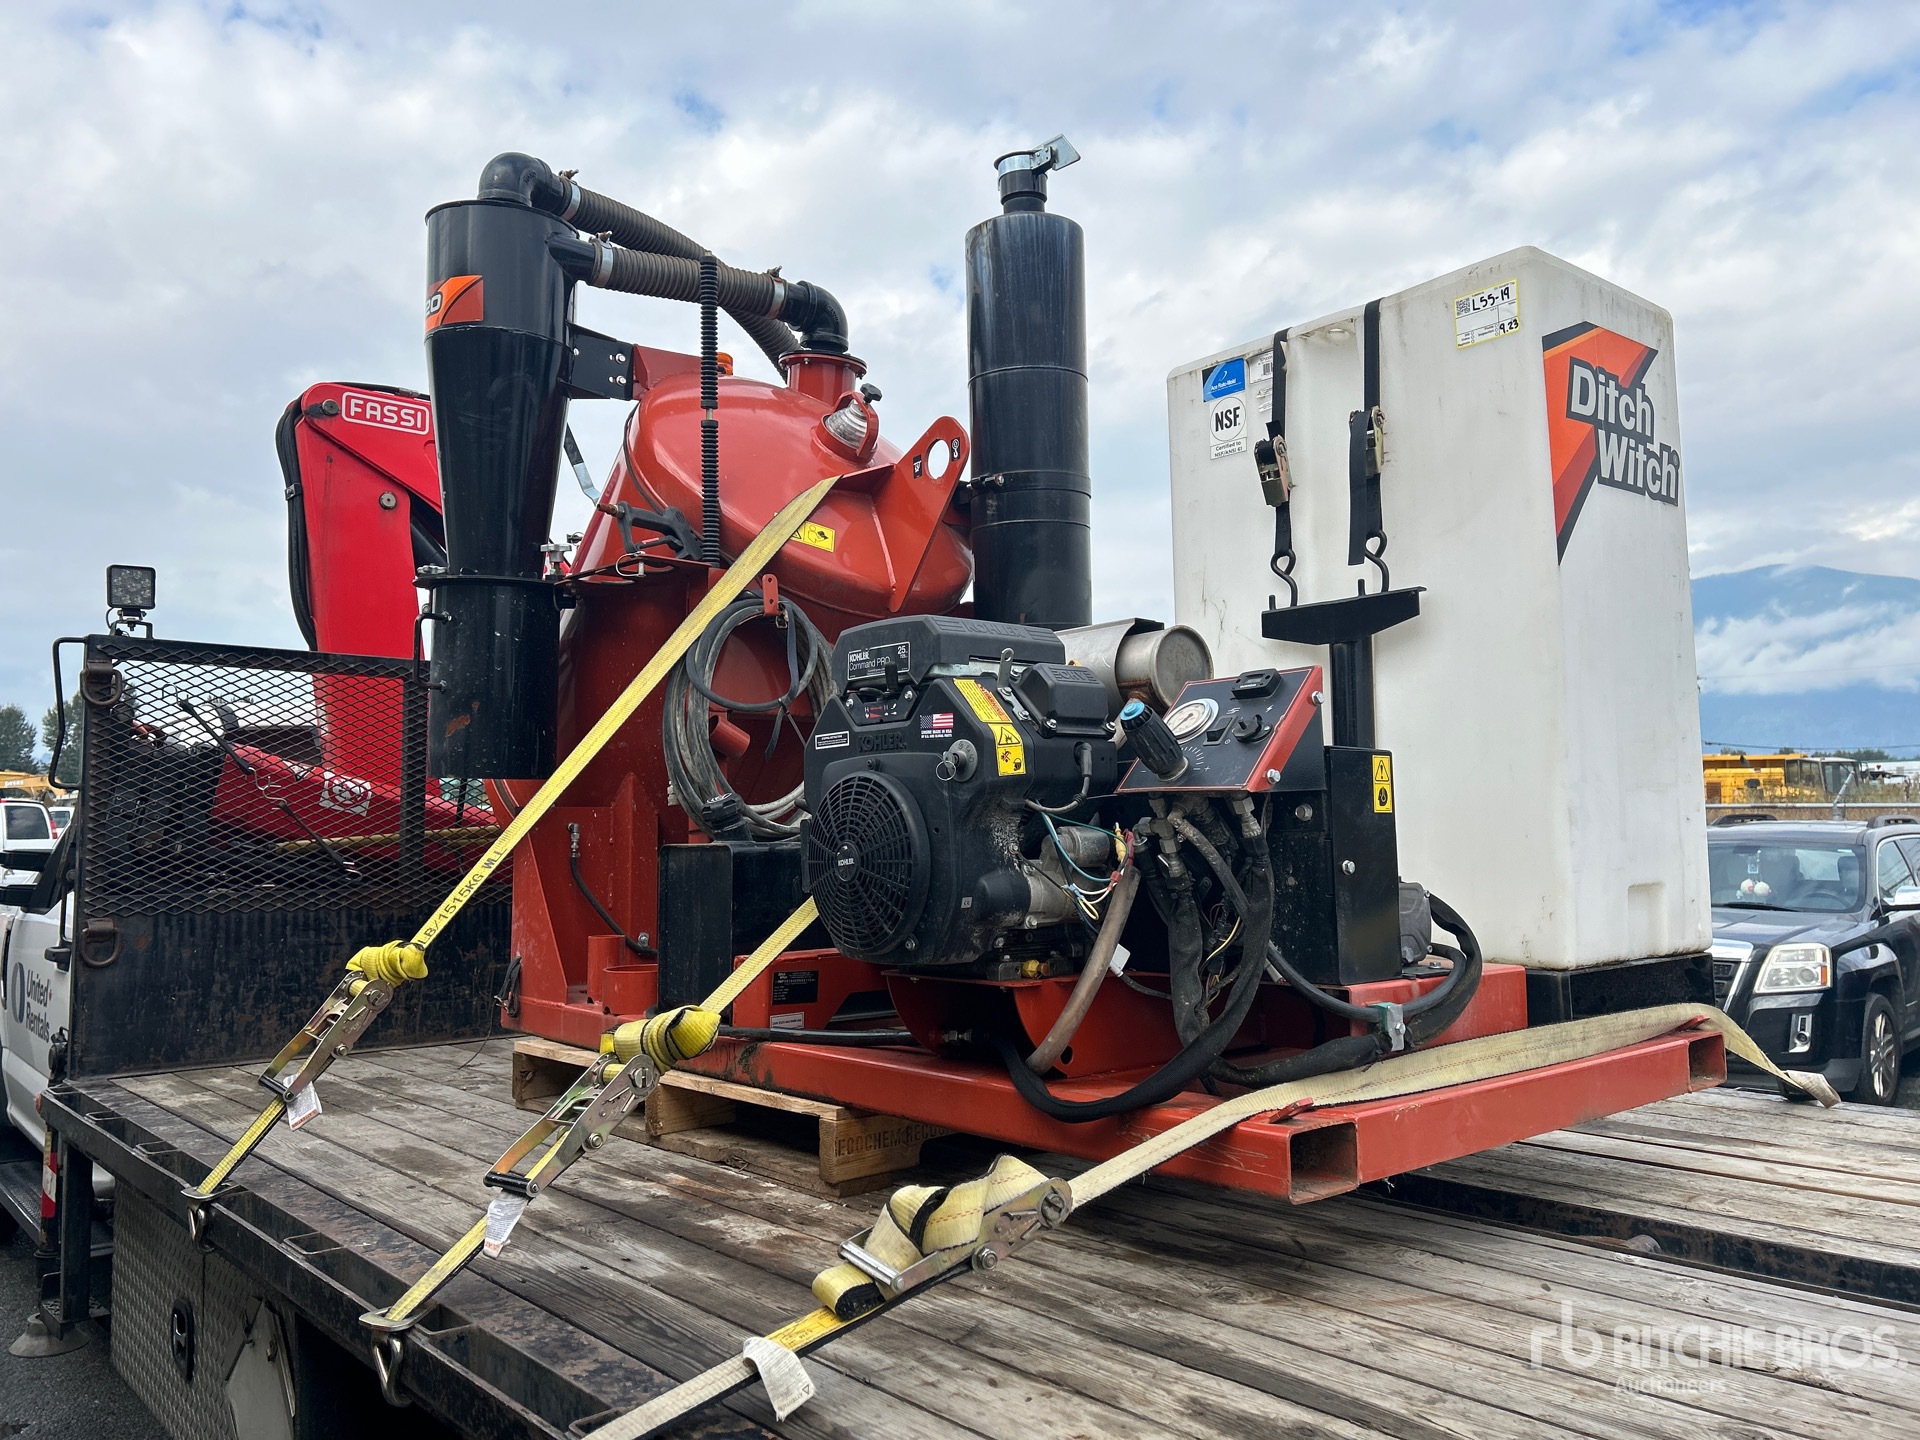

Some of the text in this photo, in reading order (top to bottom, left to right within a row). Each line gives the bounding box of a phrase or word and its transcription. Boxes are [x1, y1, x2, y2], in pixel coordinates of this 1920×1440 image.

[1472, 286, 1510, 311] L55-19
[1499, 318, 1519, 334] 9.23
[1570, 364, 1652, 437] Ditch
[350, 398, 422, 429] FASSI
[1214, 405, 1241, 433] NSF
[1215, 442, 1236, 452] Certified
[1597, 428, 1677, 500] Witch
[961, 620, 1027, 639] KOHLER
[849, 651, 870, 662] KOHLER
[897, 645, 906, 655] 25
[849, 656, 891, 671] Command PRO
[857, 731, 907, 753] KOHLER
[837, 857, 855, 867] KOHLER
[26, 968, 50, 1008] United
[25, 1001, 50, 1044] Rentals
